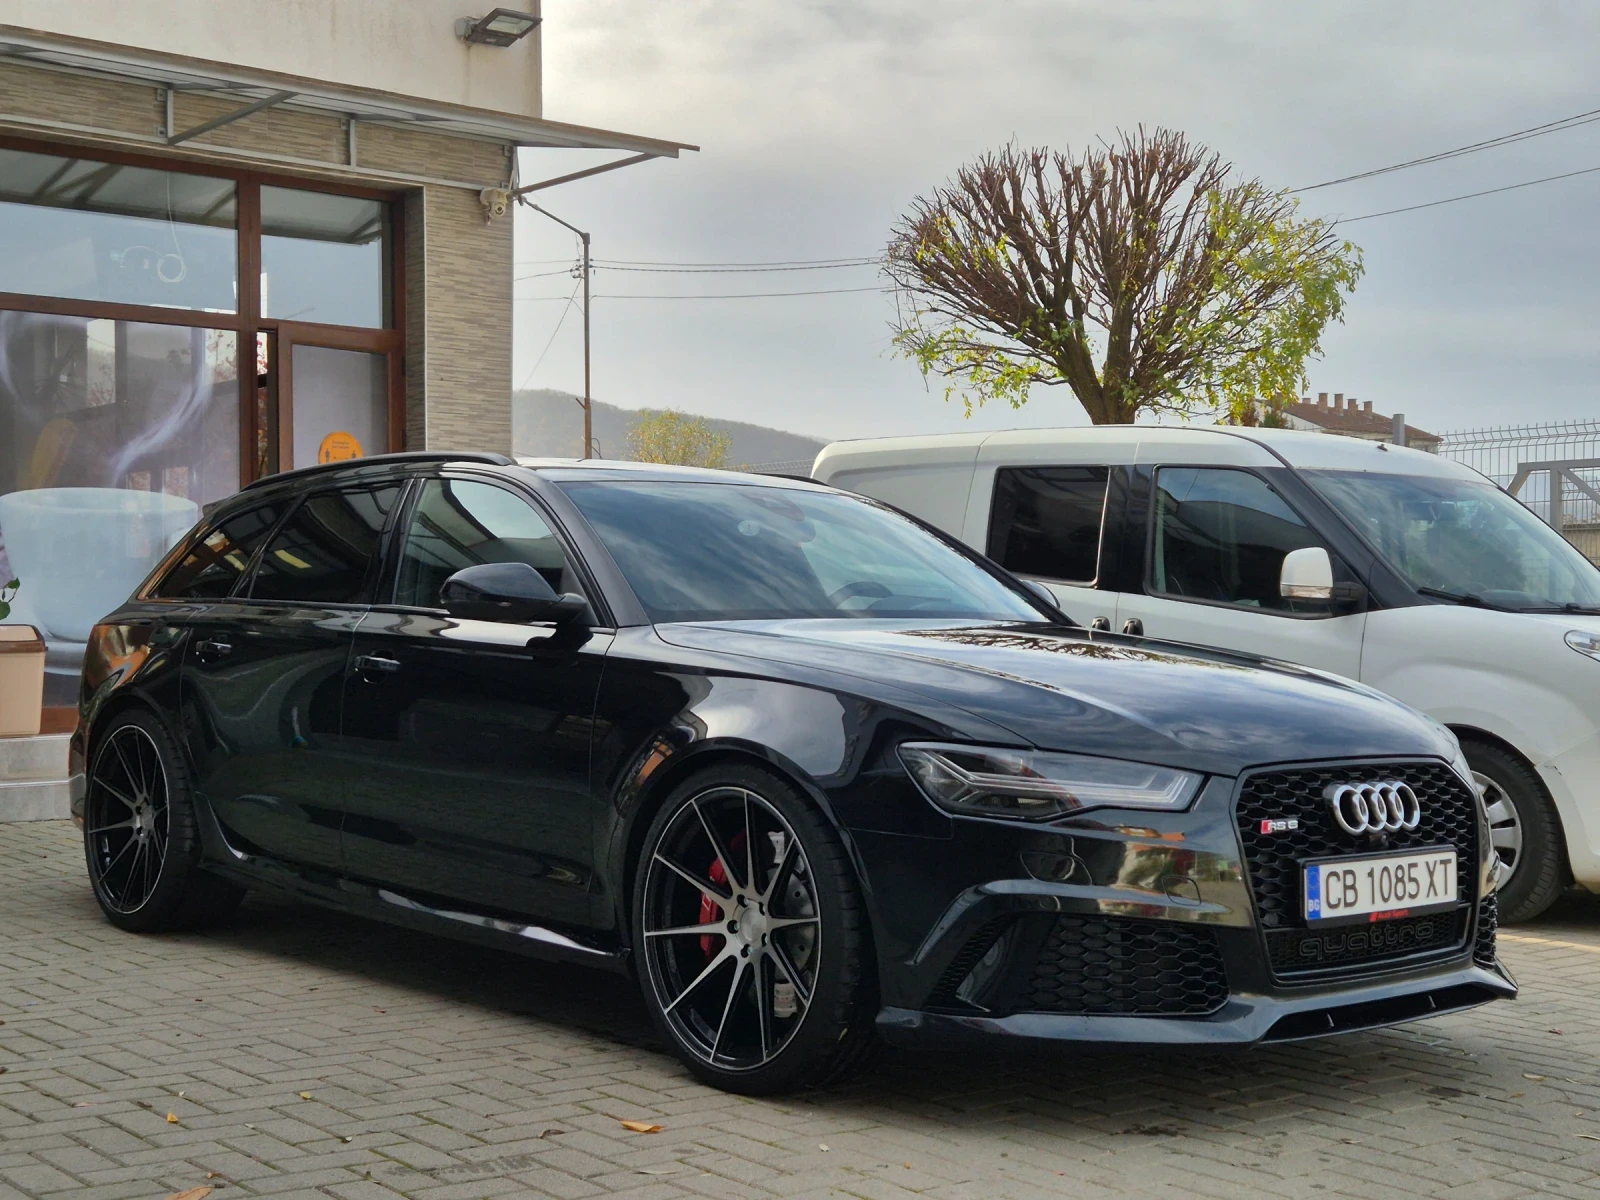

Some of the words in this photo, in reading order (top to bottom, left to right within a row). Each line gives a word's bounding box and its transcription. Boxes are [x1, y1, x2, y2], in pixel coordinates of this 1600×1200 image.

[1325, 869, 1358, 909] CB
[1367, 864, 1420, 905] 1085
[1425, 858, 1452, 898] XT
[1308, 899, 1320, 912] BG
[1300, 922, 1433, 960] quattro
